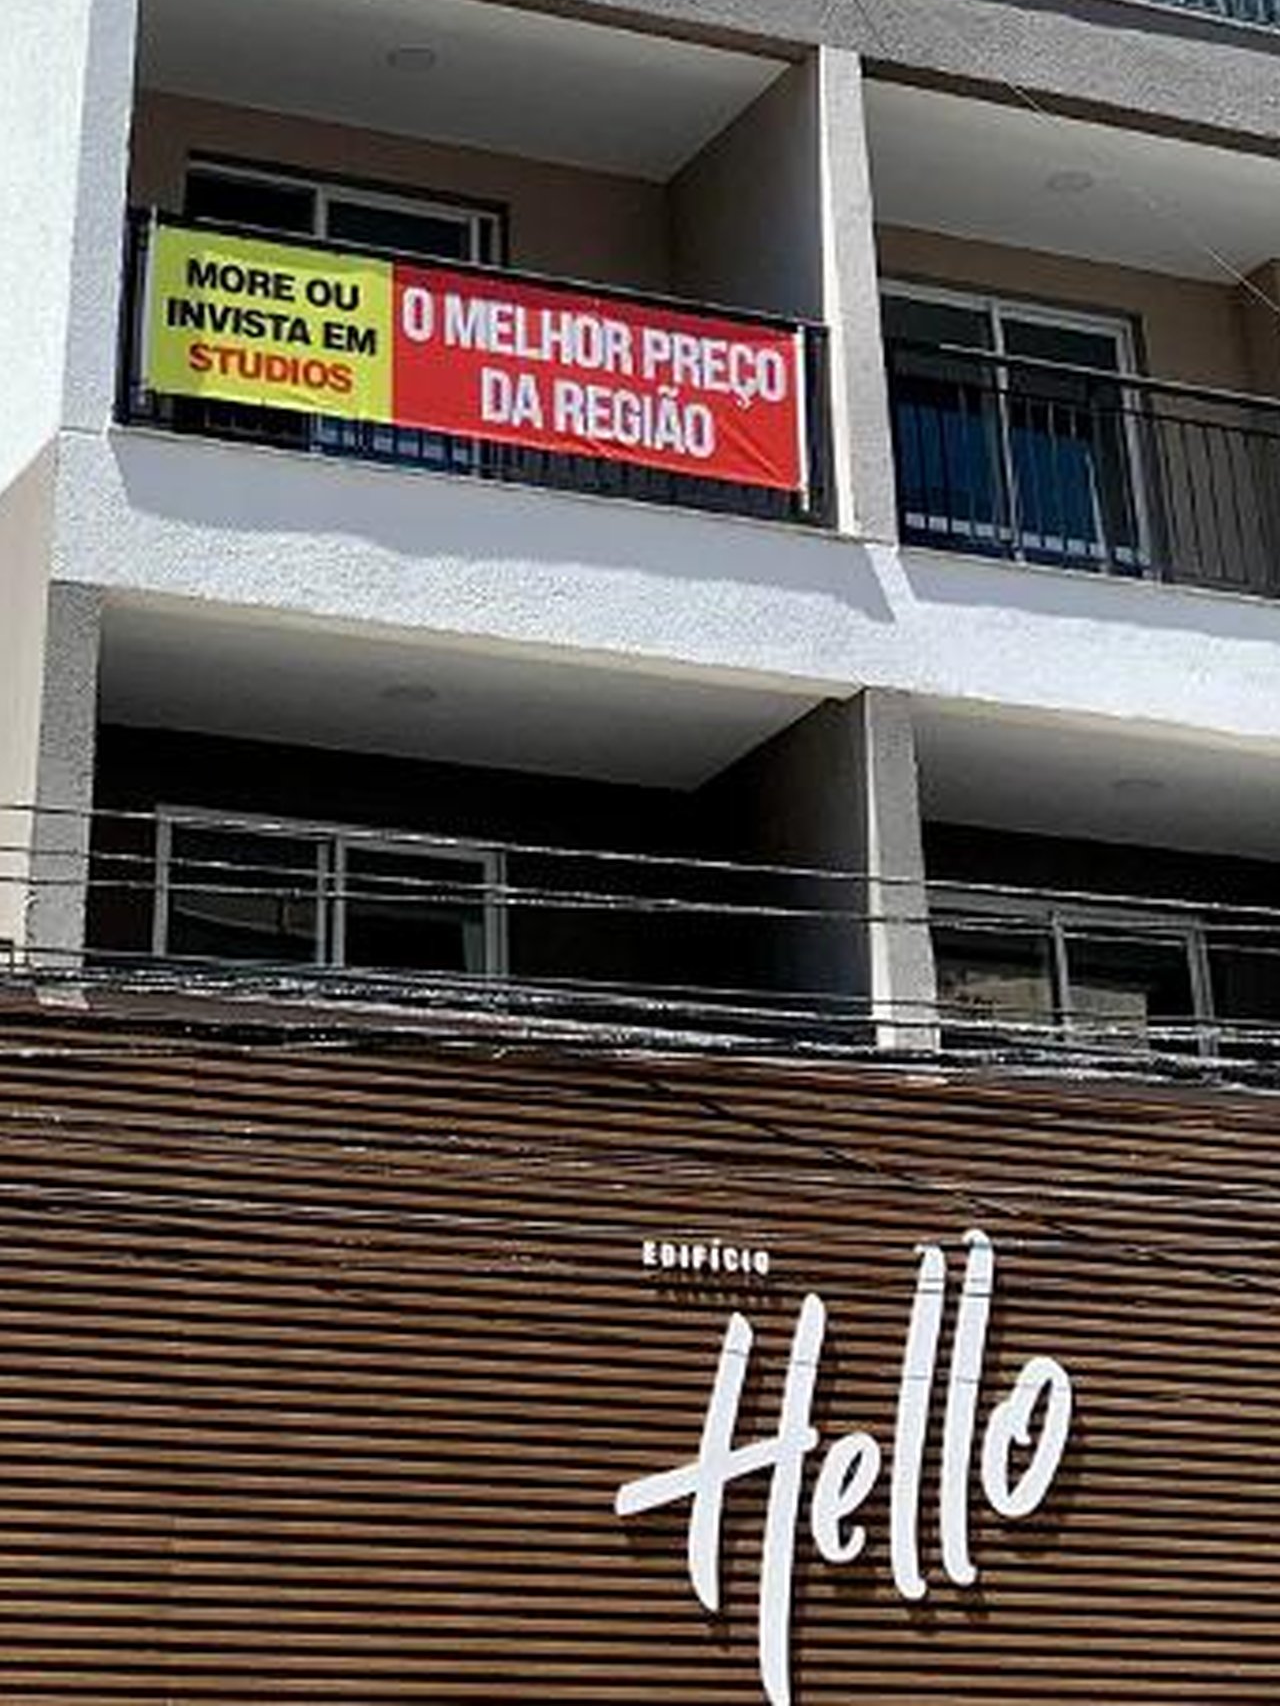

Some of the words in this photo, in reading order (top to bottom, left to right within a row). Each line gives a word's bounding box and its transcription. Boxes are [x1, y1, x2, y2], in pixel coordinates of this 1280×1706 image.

[185, 257, 296, 304] MORE
[305, 279, 360, 313] OU
[167, 297, 312, 347] INVISTA
[321, 322, 378, 356] EM
[402, 286, 435, 335] O
[444, 293, 634, 371] MELHOR
[641, 329, 788, 410] PREÇO
[188, 342, 354, 394] STUDIOS
[481, 366, 544, 431] DA
[554, 384, 715, 459] REGIÃO
[641, 1239, 771, 1275] EDIFÍCIO
[614, 1228, 1073, 1706] Hello
